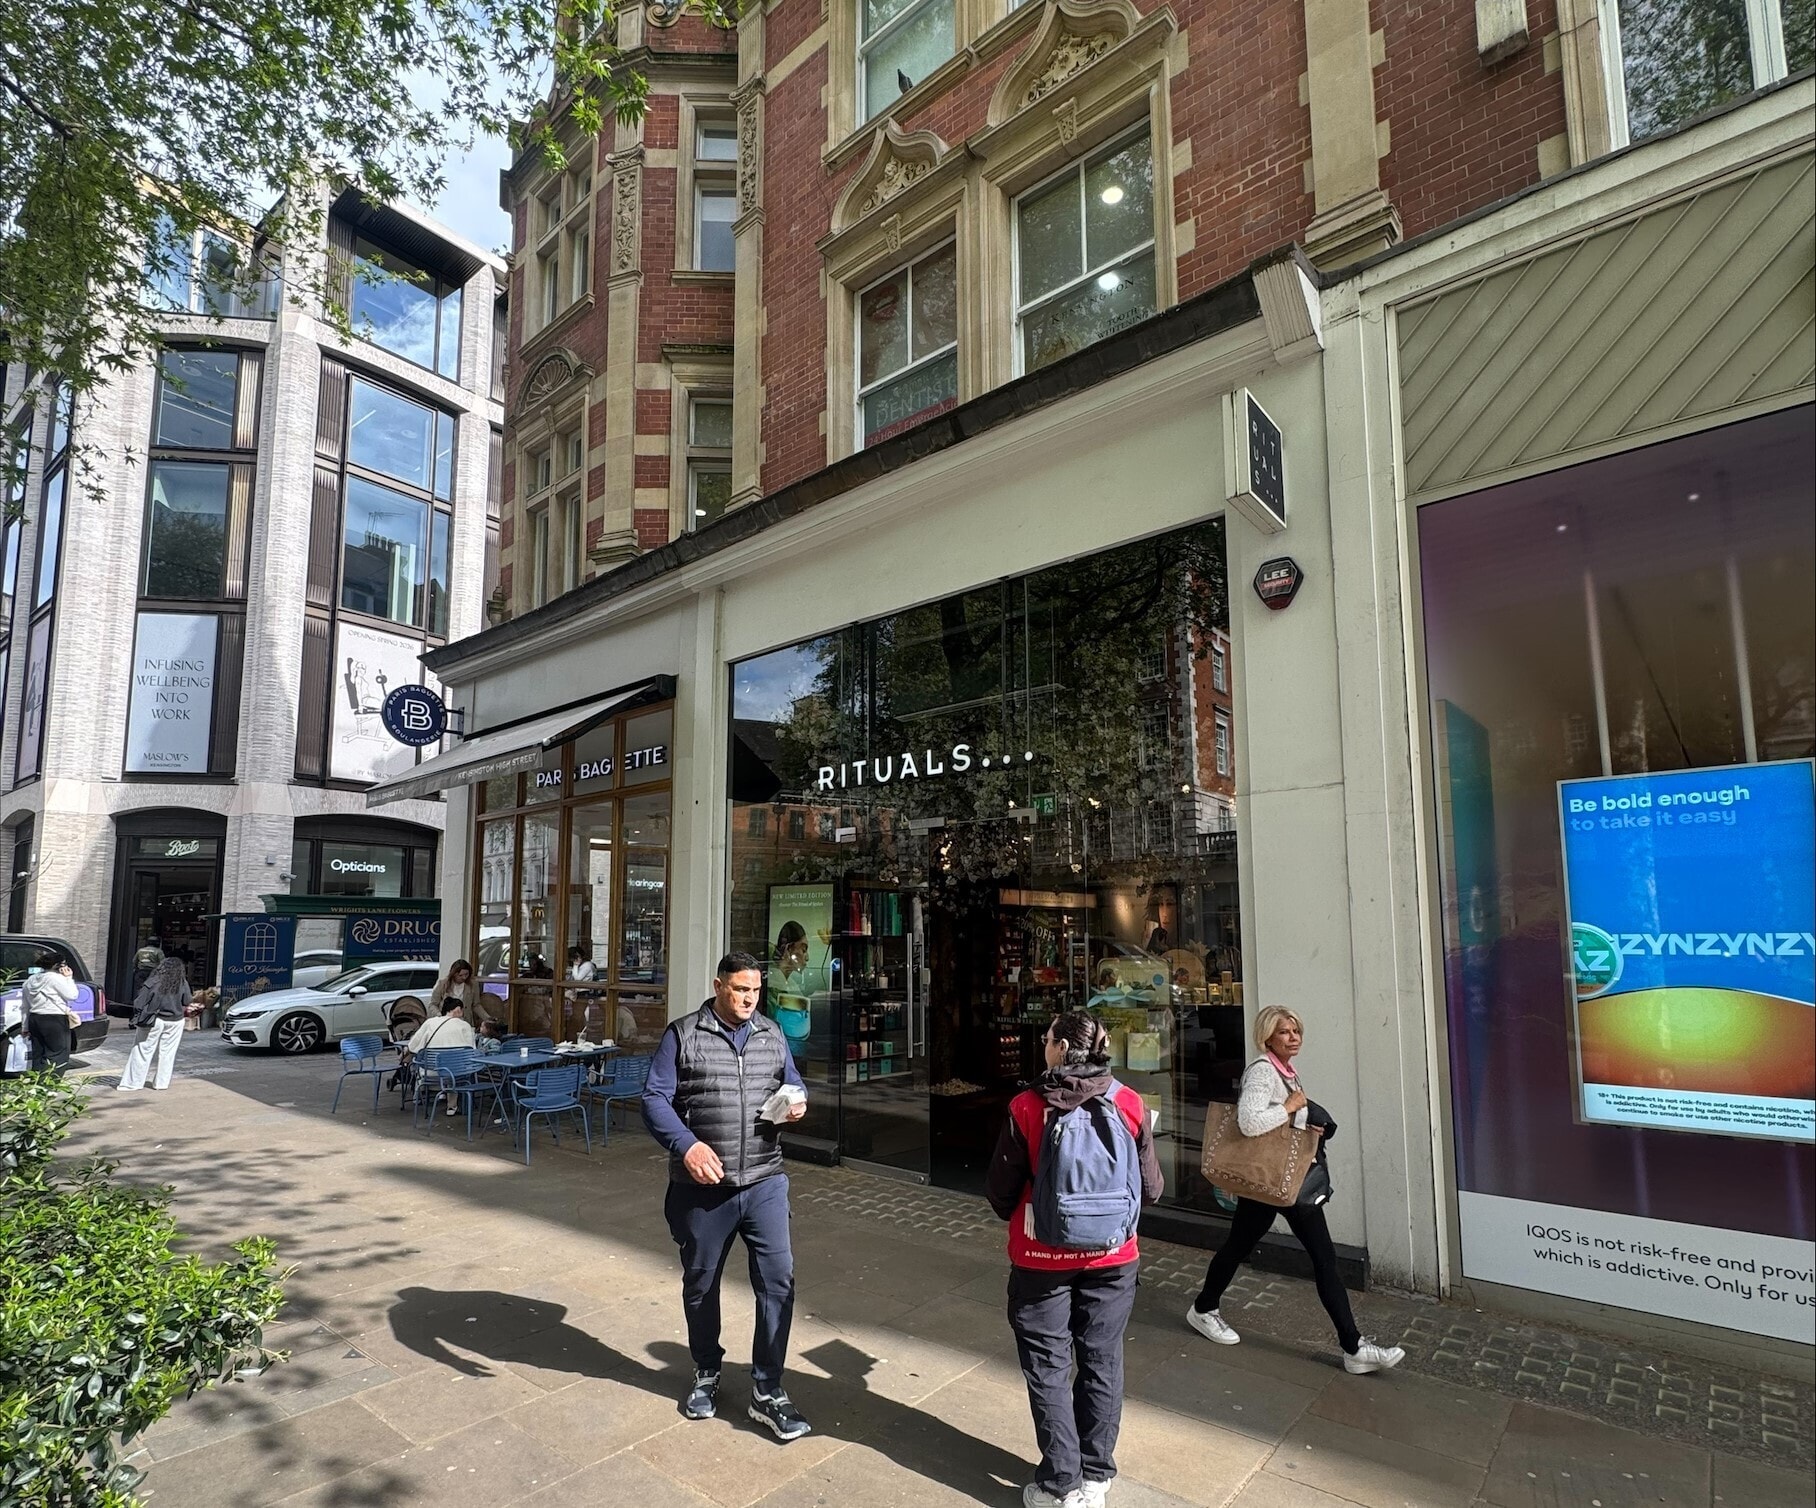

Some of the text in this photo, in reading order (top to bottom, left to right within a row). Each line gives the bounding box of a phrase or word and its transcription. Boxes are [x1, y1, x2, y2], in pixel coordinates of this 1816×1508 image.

[876, 375, 957, 428] DENTIST
[1263, 568, 1290, 581] LEE
[347, 629, 376, 641] OPENING
[377, 636, 398, 647] SPRING
[144, 659, 205, 672] INFUSING
[136, 675, 210, 688] WELLBEING
[155, 692, 189, 704] INTO
[388, 686, 445, 713] PARIS BAGUETTE
[151, 708, 192, 720] WORK
[391, 724, 442, 744] BOULANGERIE
[143, 752, 190, 762] MASLOW'S
[581, 745, 664, 780] BAGETTE
[1570, 785, 1750, 812] Be bold enough
[1571, 810, 1736, 831] to take it easy
[330, 858, 386, 874] Opticians
[331, 906, 366, 914] WRIGHTS
[1627, 1095, 1656, 1103] product
[1679, 1099, 1712, 1107] risk-free
[1617, 1107, 1648, 1115] continue
[1733, 1117, 1766, 1125] nicotine
[1695, 1106, 1705, 1114] by
[1031, 1251, 1051, 1259] HAND
[1086, 1250, 1105, 1258] HAND
[1526, 1224, 1814, 1283] IQOS is not risk-free and provi
[1533, 1247, 1583, 1266] which
[1588, 1254, 1601, 1269] is
[1606, 1260, 1699, 1286] addictive.
[1704, 1275, 1752, 1300] Only
[1757, 1284, 1789, 1302] for
